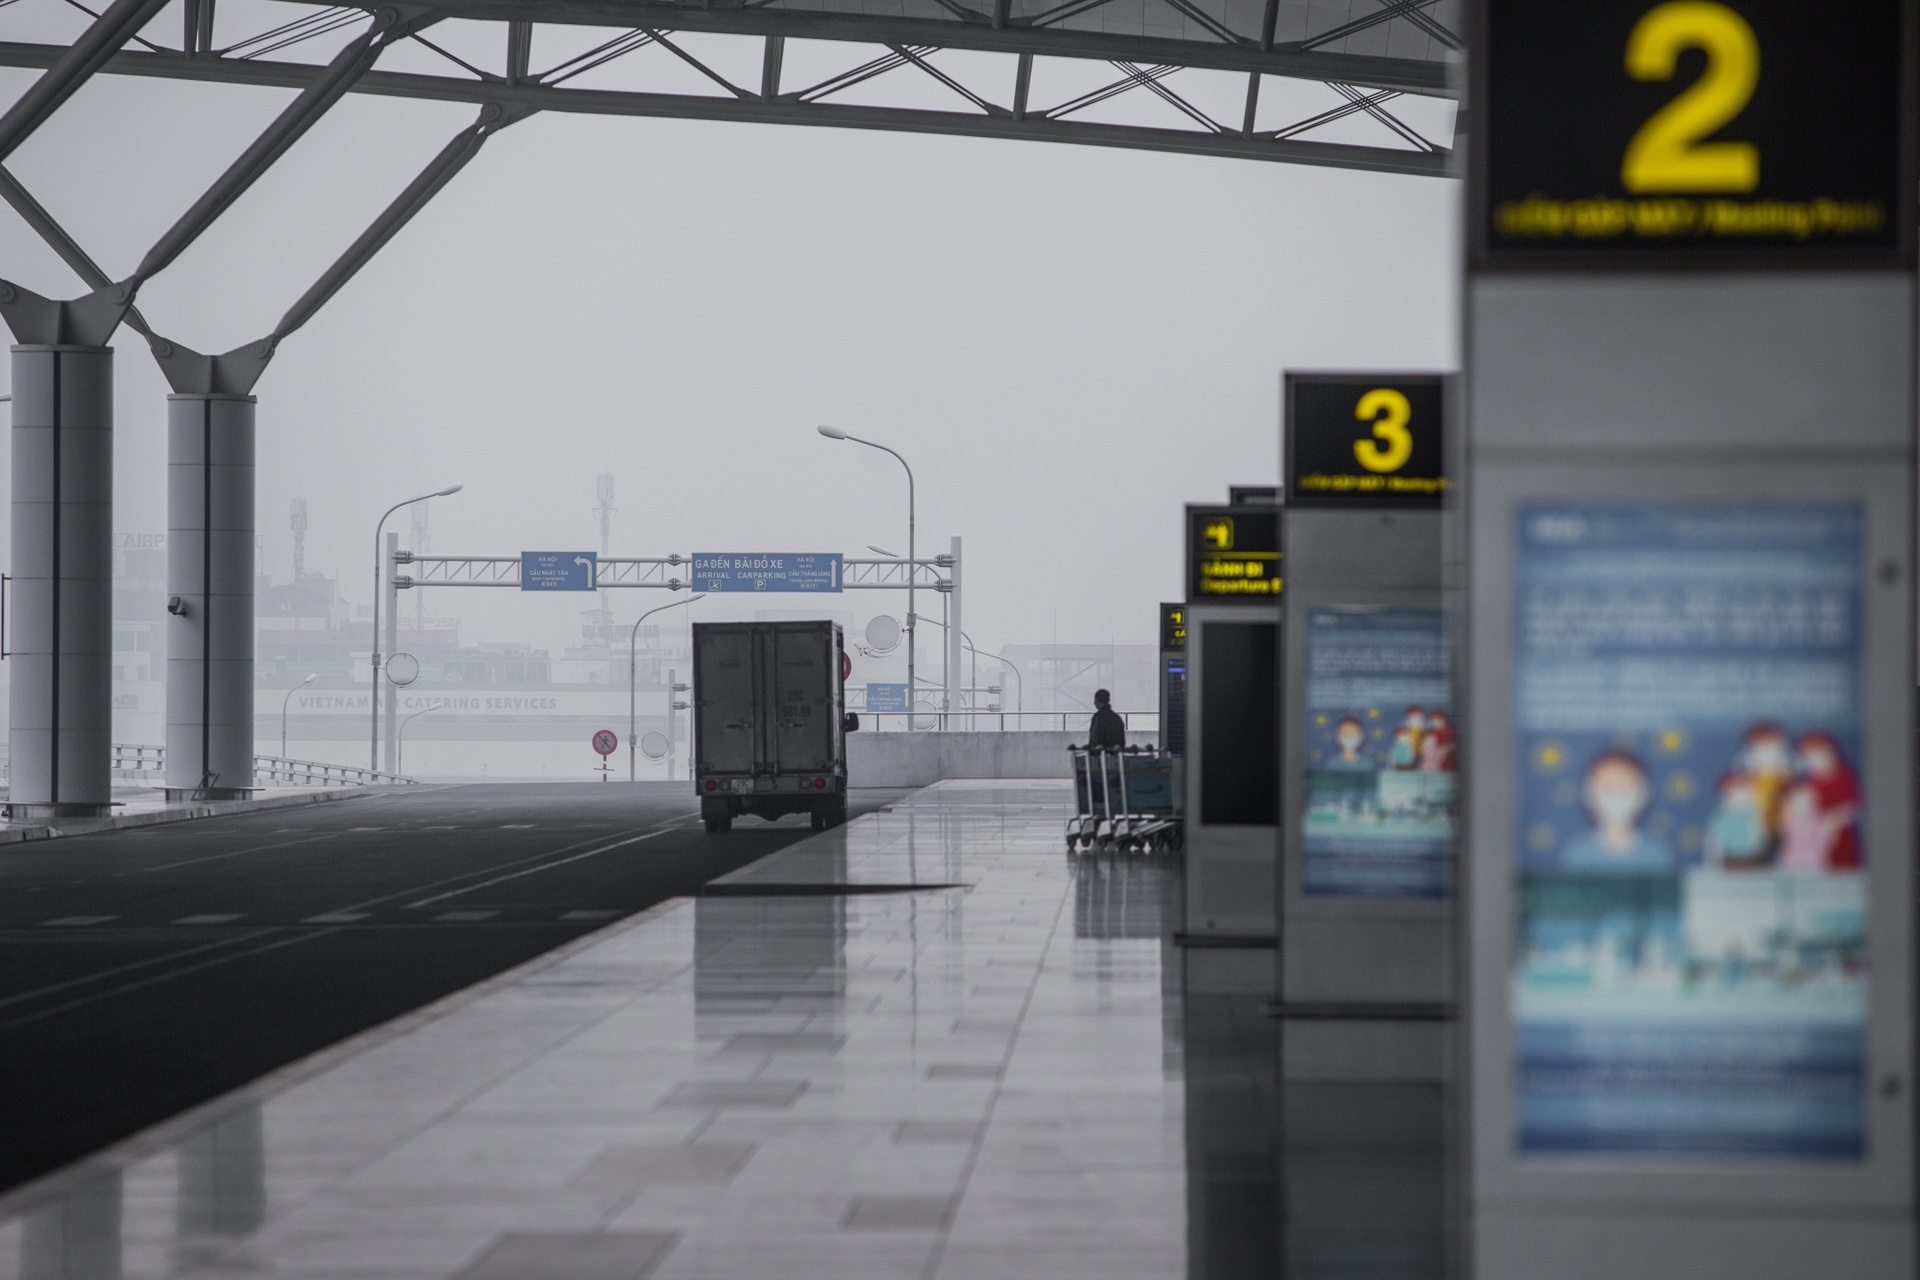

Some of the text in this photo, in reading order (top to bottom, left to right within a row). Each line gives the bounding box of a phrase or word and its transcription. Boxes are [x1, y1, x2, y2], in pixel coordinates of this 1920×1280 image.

[1623, 0, 1760, 194] 2
[1353, 388, 1413, 473] 3
[695, 559, 709, 569] GA
[710, 555, 730, 569] ĐẾN
[770, 559, 784, 569] XE
[299, 697, 369, 708] VIETNAM
[404, 697, 480, 709] CATERING
[485, 697, 557, 709] SERVICES
